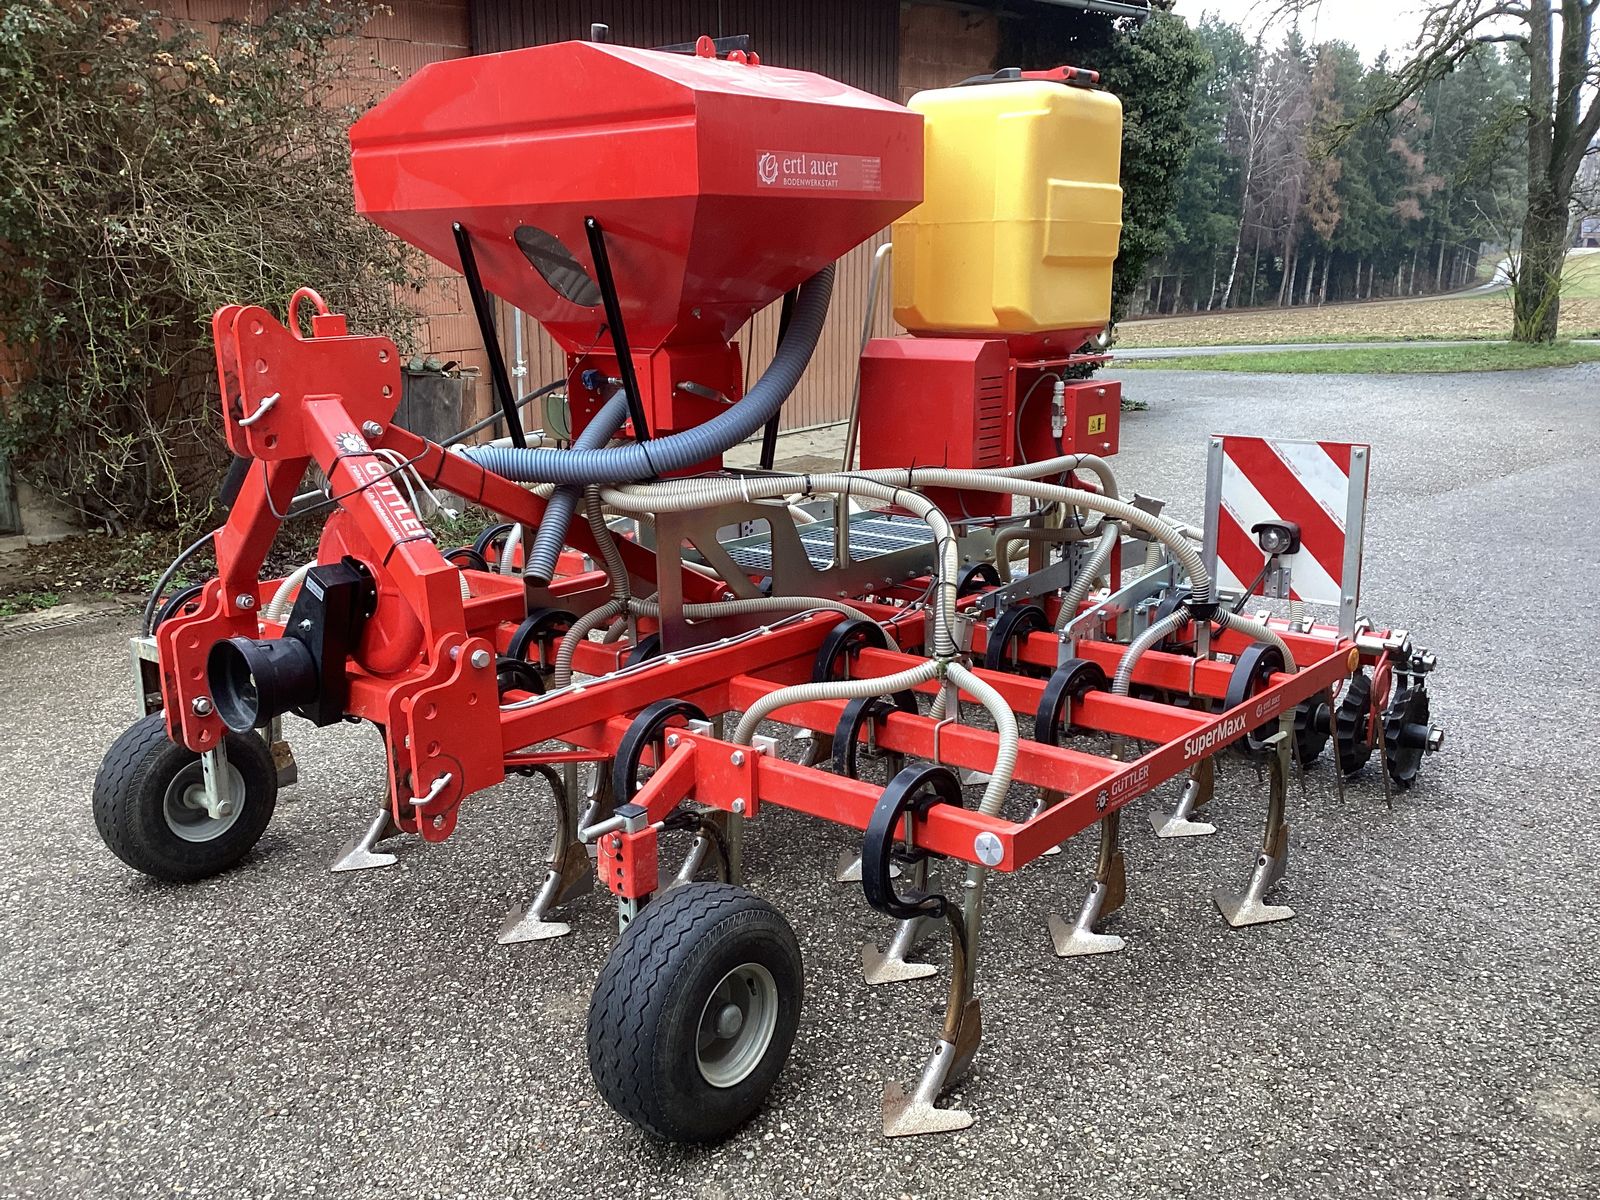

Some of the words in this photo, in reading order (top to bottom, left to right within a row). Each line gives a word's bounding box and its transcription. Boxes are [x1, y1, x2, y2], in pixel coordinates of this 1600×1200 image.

[783, 154, 806, 174] ertl
[810, 160, 838, 176] auer
[783, 178, 838, 187] BODENWERKSTATT
[1184, 712, 1247, 760] SuperMaxx
[1111, 765, 1149, 796] GÜTTLER
